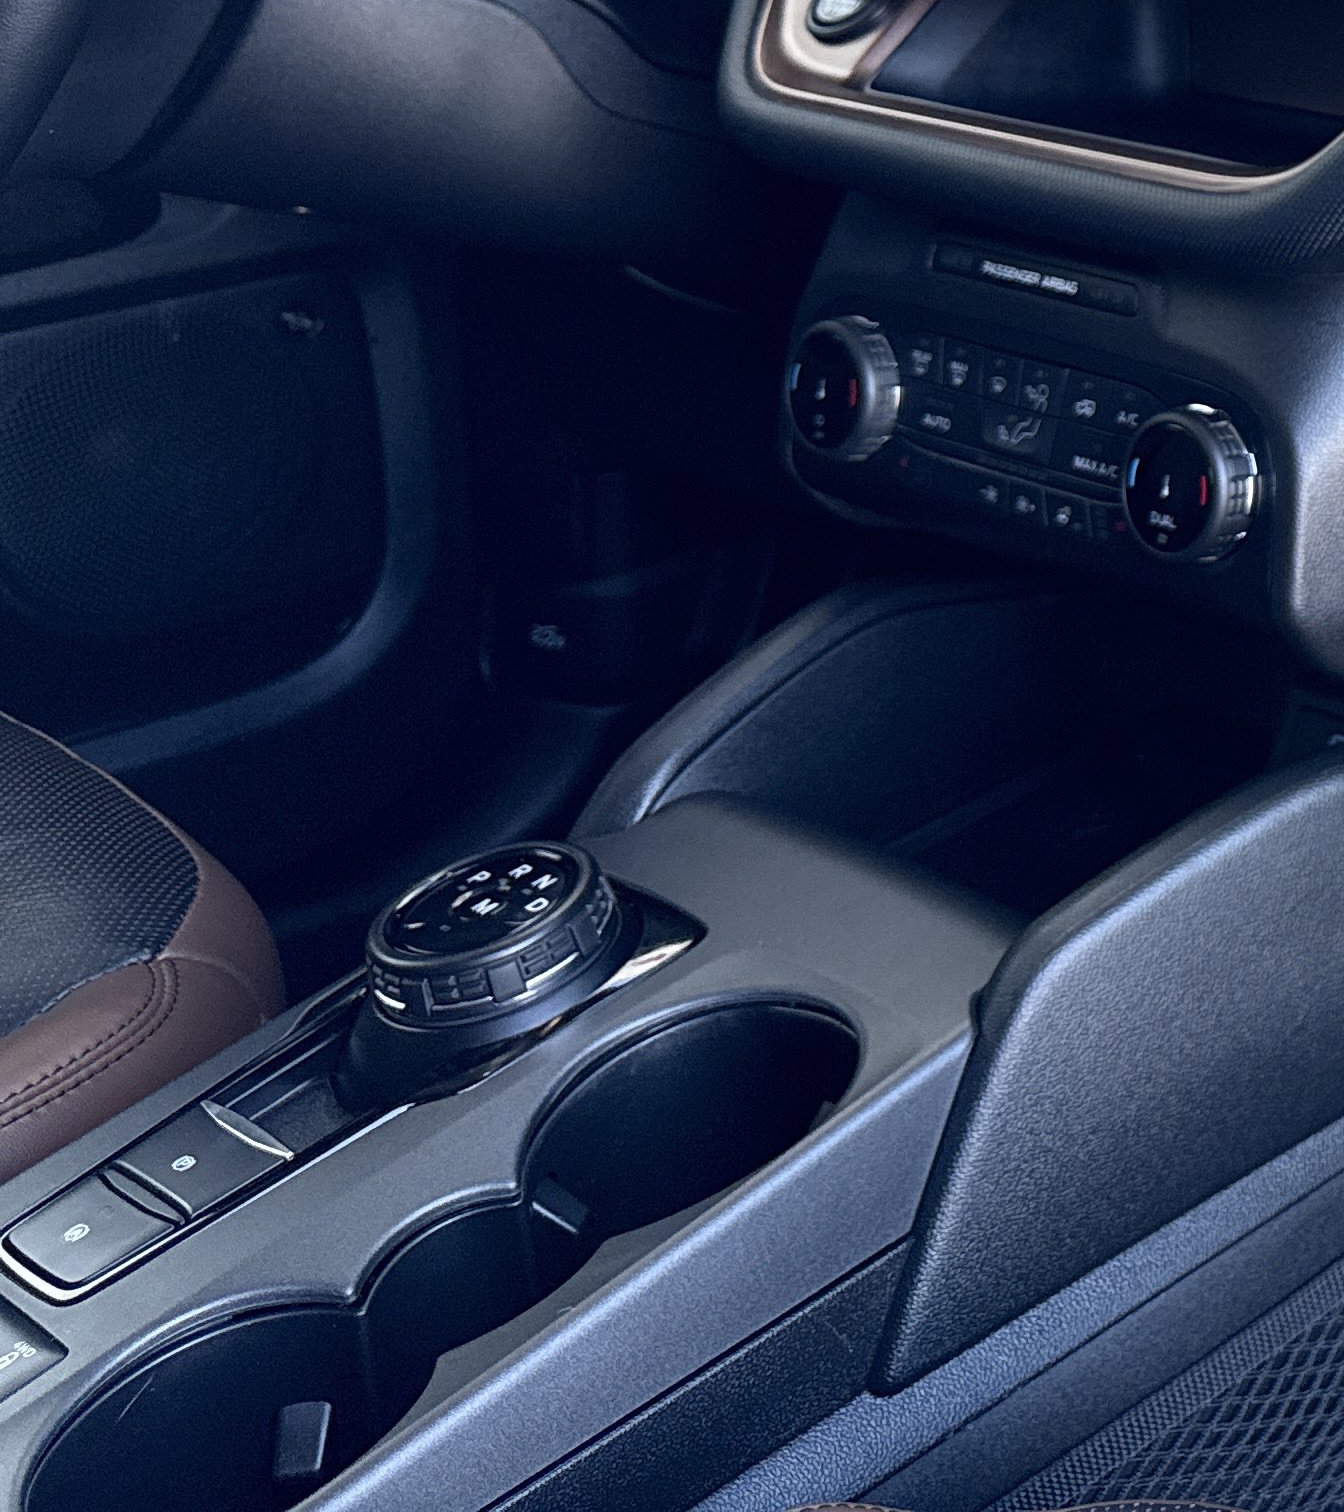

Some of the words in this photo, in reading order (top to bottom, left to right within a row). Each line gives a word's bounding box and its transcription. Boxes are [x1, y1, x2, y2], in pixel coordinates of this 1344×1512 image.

[920, 412, 952, 434] AUTO
[1115, 410, 1140, 428] A/C
[466, 870, 492, 884] P
[508, 863, 533, 879] R
[530, 873, 559, 890] N
[470, 897, 500, 916] M
[524, 896, 550, 913] D
